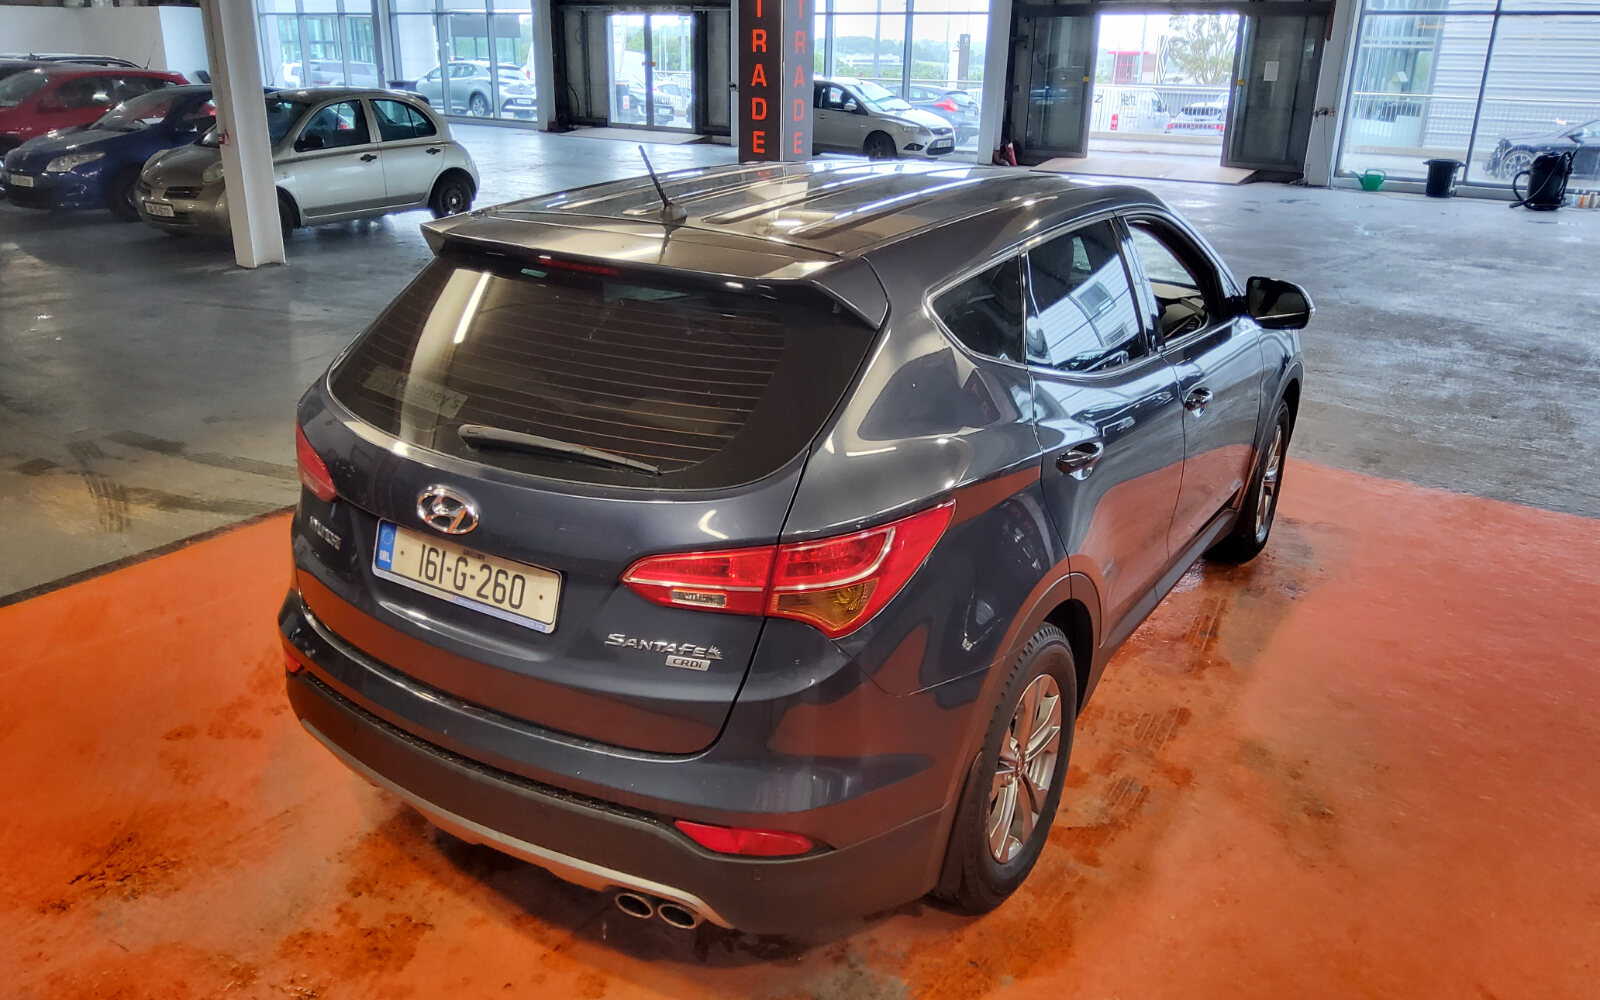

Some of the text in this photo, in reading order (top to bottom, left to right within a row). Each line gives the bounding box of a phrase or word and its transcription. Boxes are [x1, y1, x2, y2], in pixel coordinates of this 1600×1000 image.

[793, 0, 806, 154] TRADE
[1120, 92, 1136, 107] Hertz
[379, 550, 391, 562] IRL
[418, 544, 526, 610] 161-G-260
[672, 658, 702, 669] CRDi
